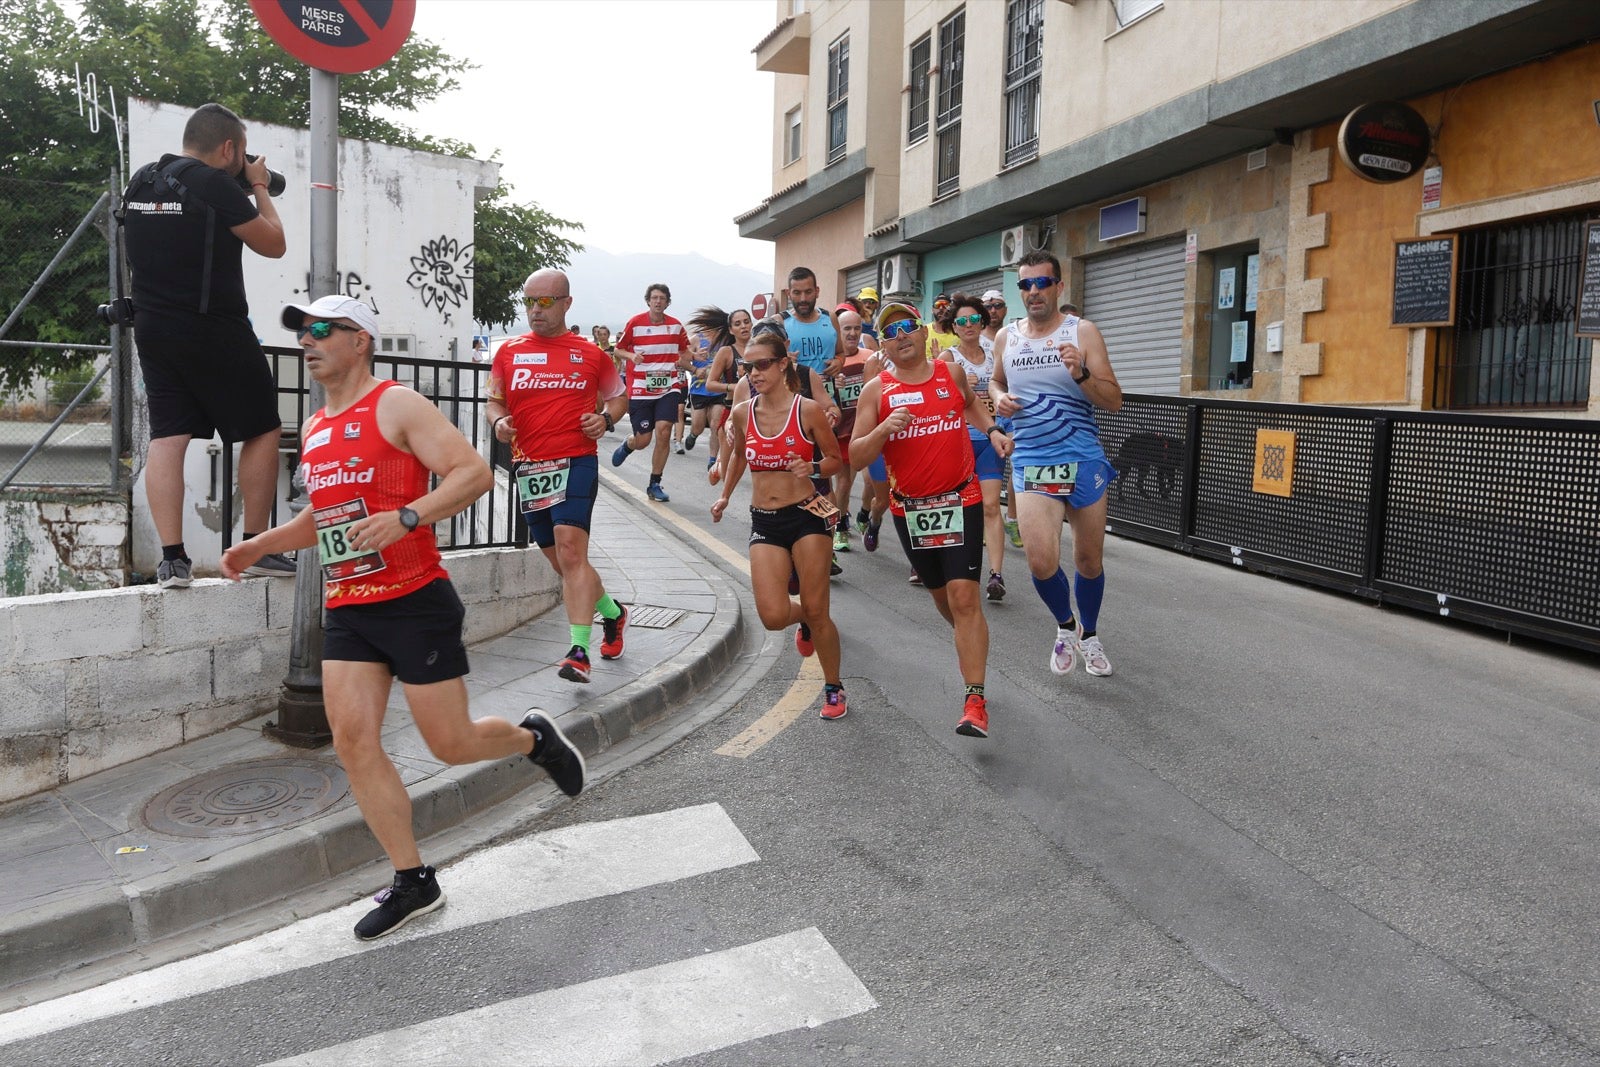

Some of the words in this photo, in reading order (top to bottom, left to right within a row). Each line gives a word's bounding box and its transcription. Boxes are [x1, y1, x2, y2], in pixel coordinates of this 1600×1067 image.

[301, 5, 345, 24] MESES
[301, 19, 341, 36] PARES
[1011, 354, 1064, 368] MARACEN
[510, 368, 588, 391] Polisalud
[651, 378, 668, 387] 300
[1034, 463, 1071, 480] 713
[528, 473, 562, 496] 620
[916, 509, 955, 532] 627
